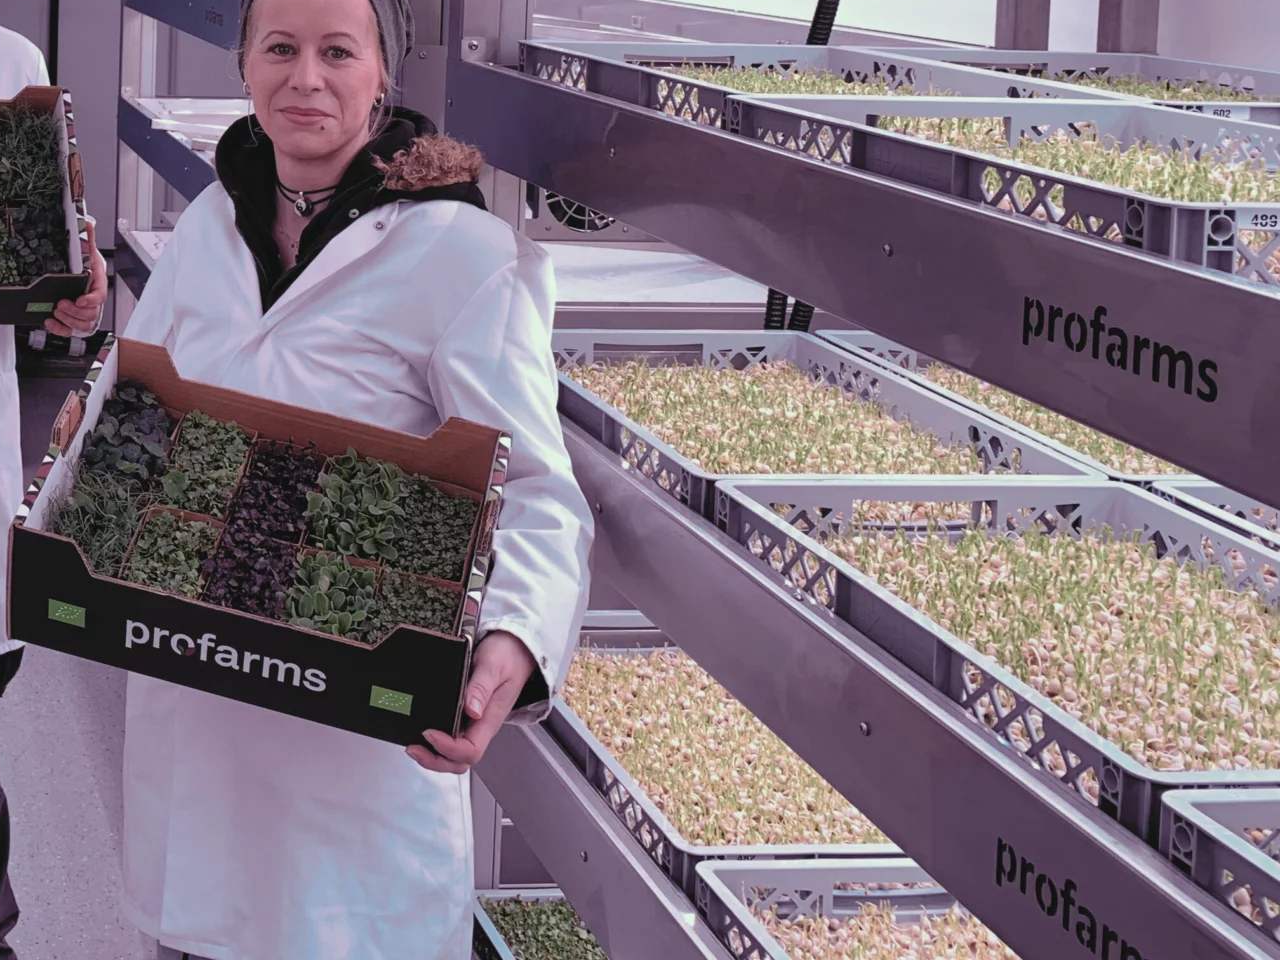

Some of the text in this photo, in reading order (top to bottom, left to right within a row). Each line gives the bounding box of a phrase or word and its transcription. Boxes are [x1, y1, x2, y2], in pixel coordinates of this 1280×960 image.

[1250, 214, 1278, 228] 489
[1022, 296, 1218, 403] profarms
[124, 619, 327, 692] profarms
